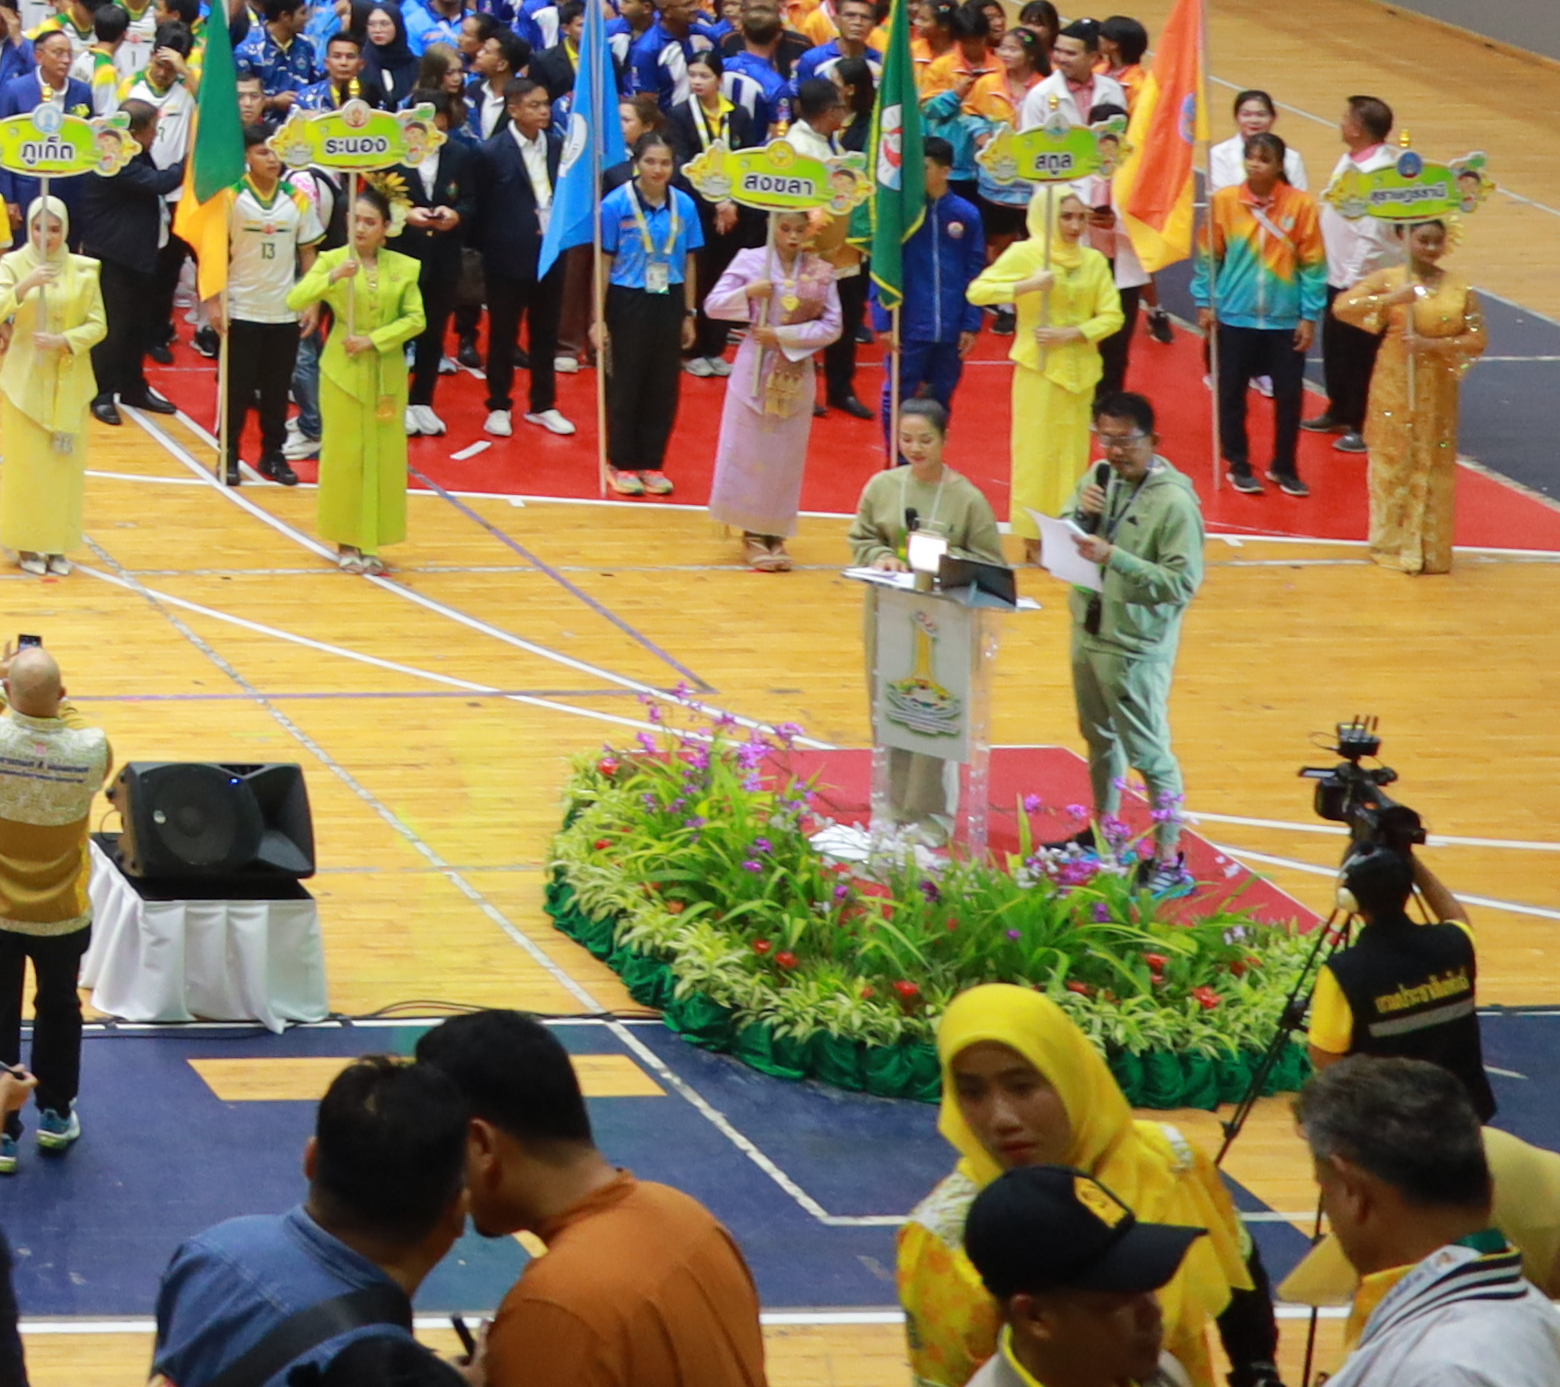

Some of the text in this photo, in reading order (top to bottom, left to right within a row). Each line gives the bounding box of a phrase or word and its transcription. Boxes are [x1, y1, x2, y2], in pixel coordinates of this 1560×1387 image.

[22, 136, 73, 165] ภูเก็ต
[325, 138, 387, 154] ระนอง
[1034, 152, 1071, 174] สตูล
[743, 173, 813, 195] สงขลา
[261, 242, 276, 259] 13
